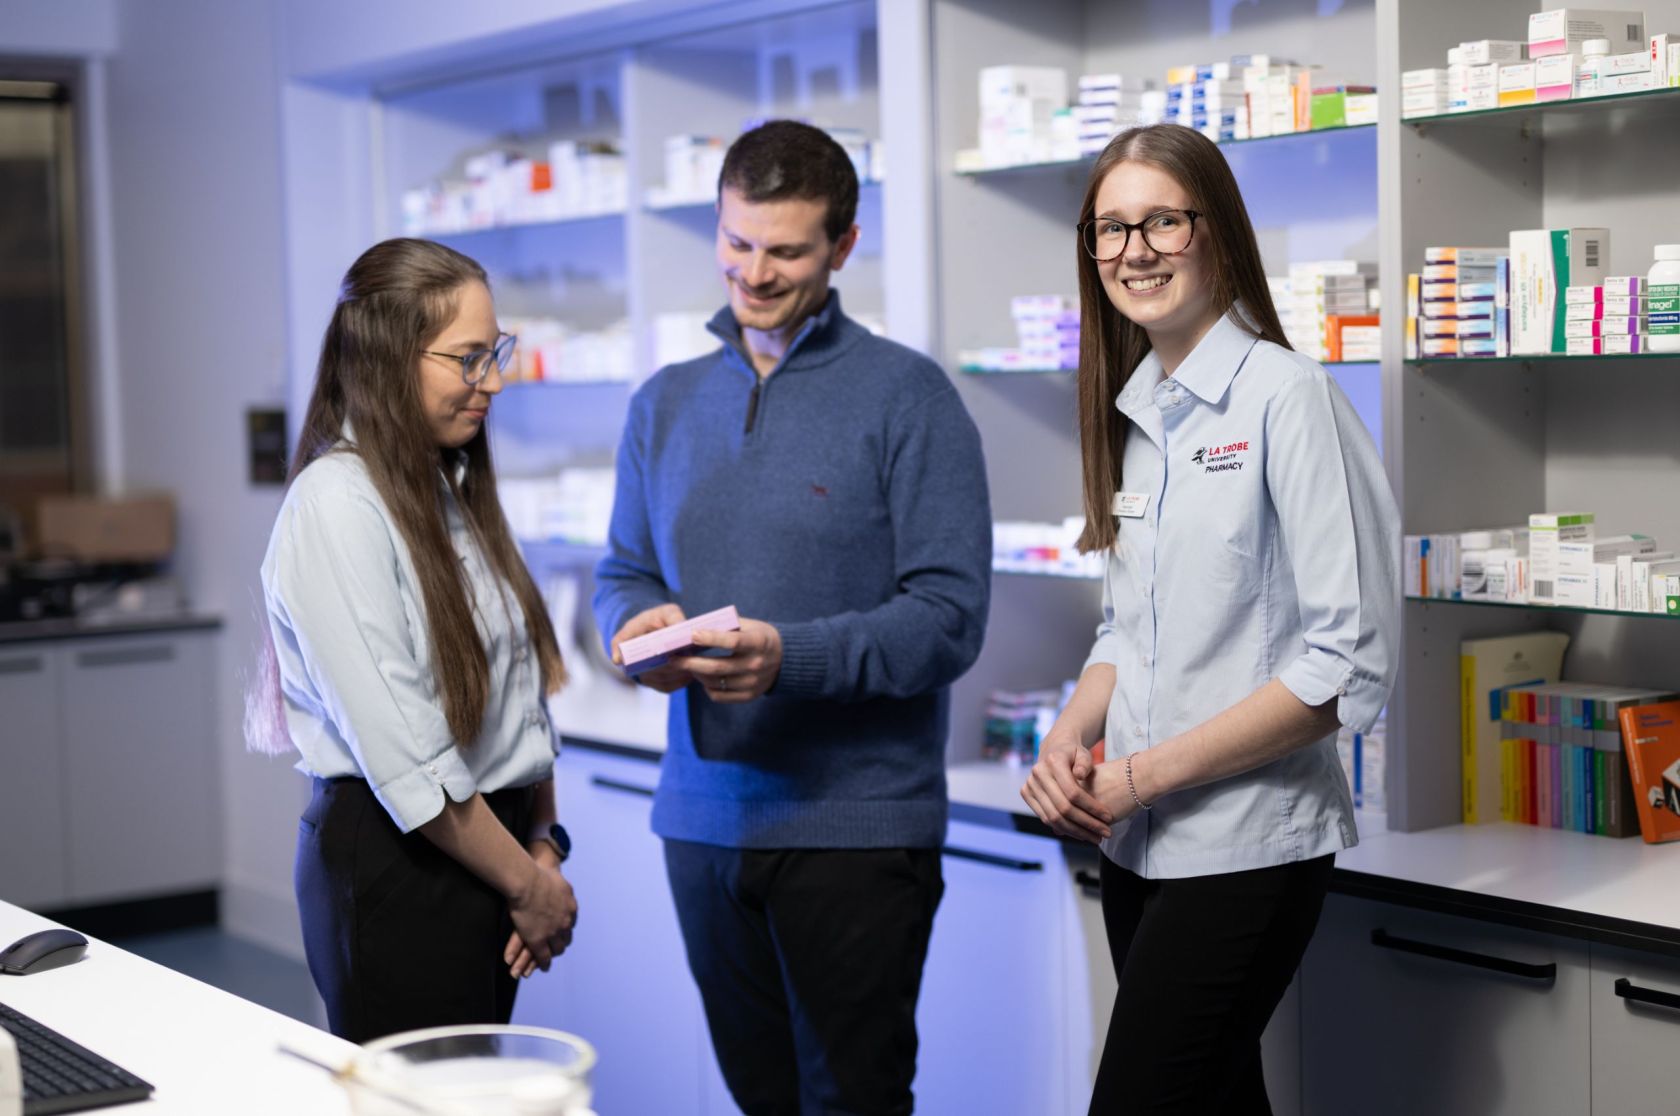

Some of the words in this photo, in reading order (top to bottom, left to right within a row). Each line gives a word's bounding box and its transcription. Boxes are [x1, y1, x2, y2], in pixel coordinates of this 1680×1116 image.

[1208, 446, 1220, 456] LA
[1222, 441, 1249, 454] TROBE
[1207, 453, 1237, 463] UNIVERSITY
[1205, 461, 1243, 474] PHARMACY
